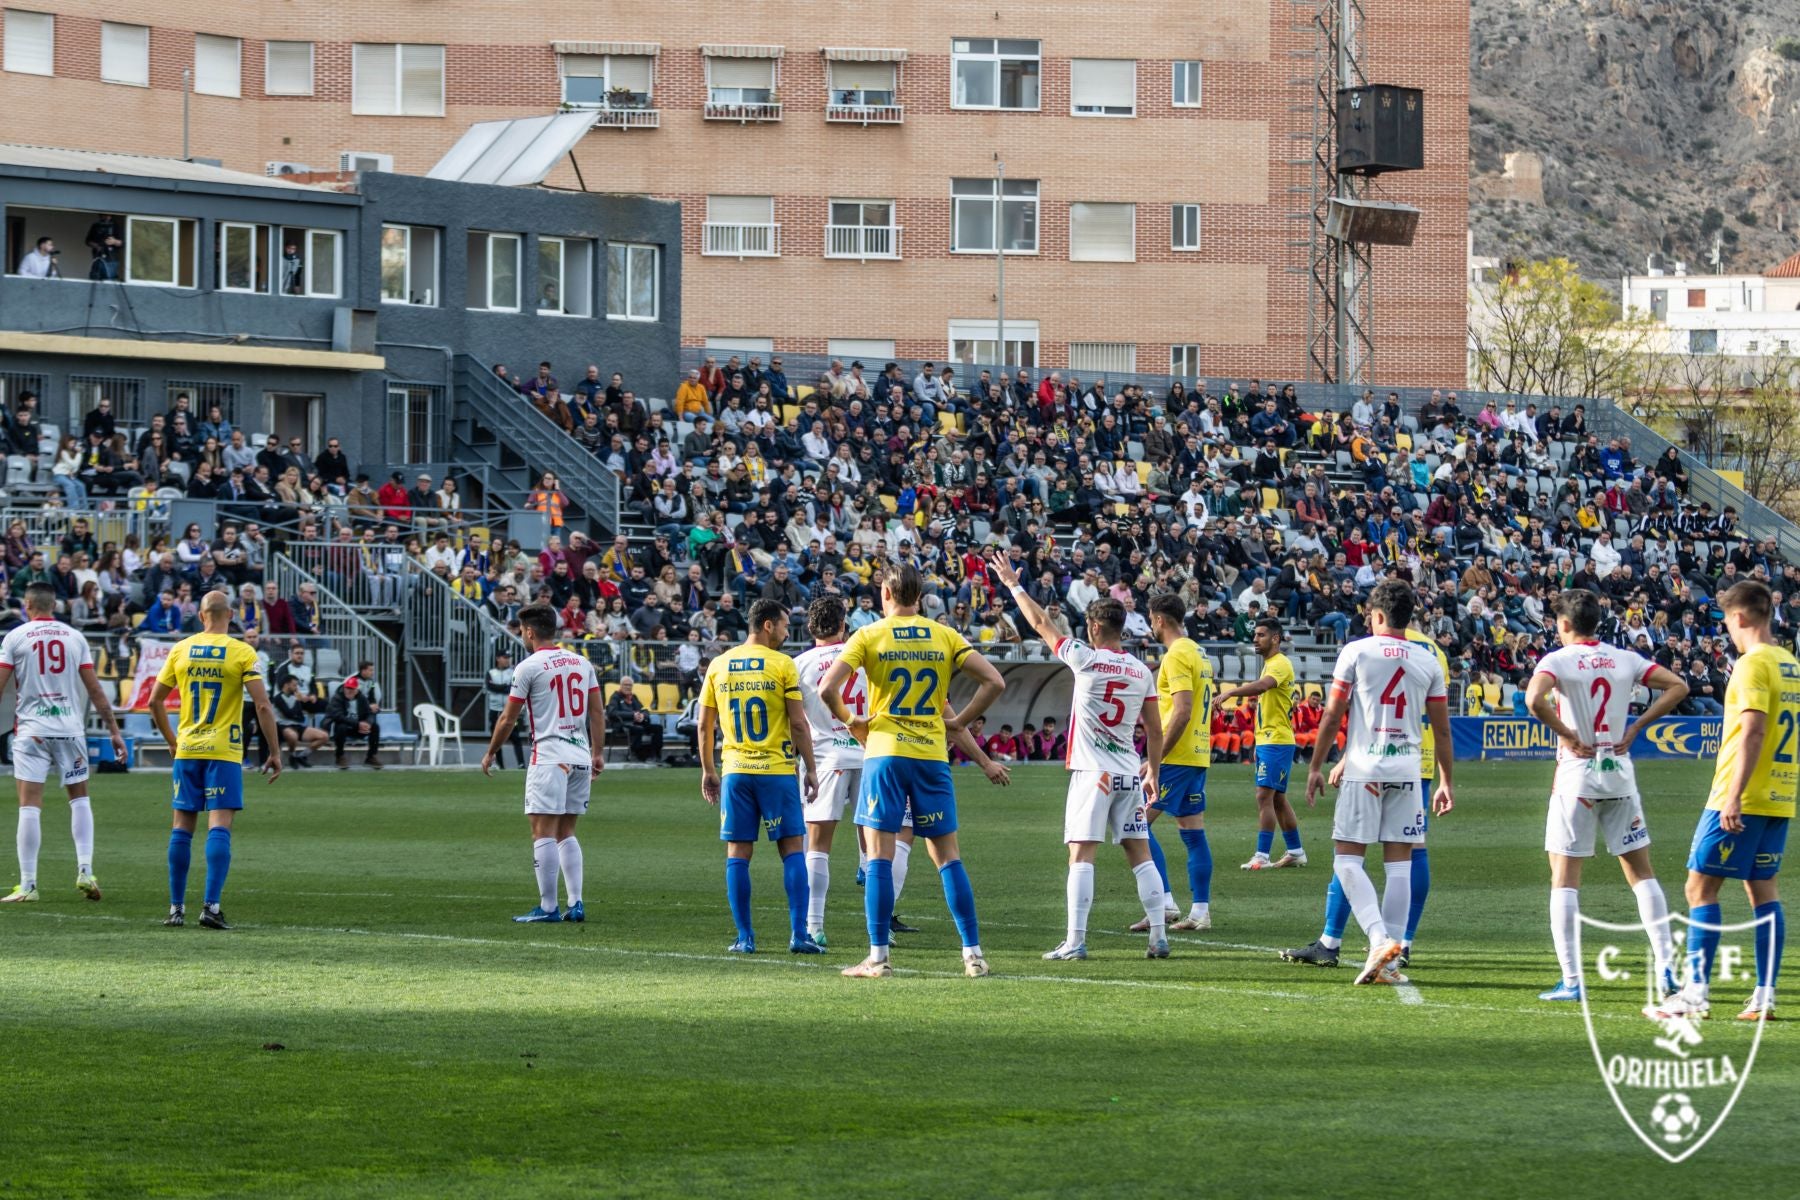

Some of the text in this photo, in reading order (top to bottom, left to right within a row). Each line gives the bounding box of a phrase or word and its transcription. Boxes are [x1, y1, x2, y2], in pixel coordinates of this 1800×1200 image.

[32, 640, 65, 675] 19
[187, 666, 224, 678] KAMAL
[730, 661, 743, 670] TM
[879, 651, 945, 662] MENDINUETA
[1384, 648, 1409, 659] GUTI
[190, 681, 222, 724] 17
[550, 672, 584, 718] 16
[730, 681, 744, 692] LAS
[746, 681, 776, 691] CUEVAS
[889, 667, 938, 715] 22
[1098, 681, 1129, 727] 5
[1380, 666, 1407, 718] 4
[1590, 676, 1612, 732] 2
[729, 696, 768, 742] 10
